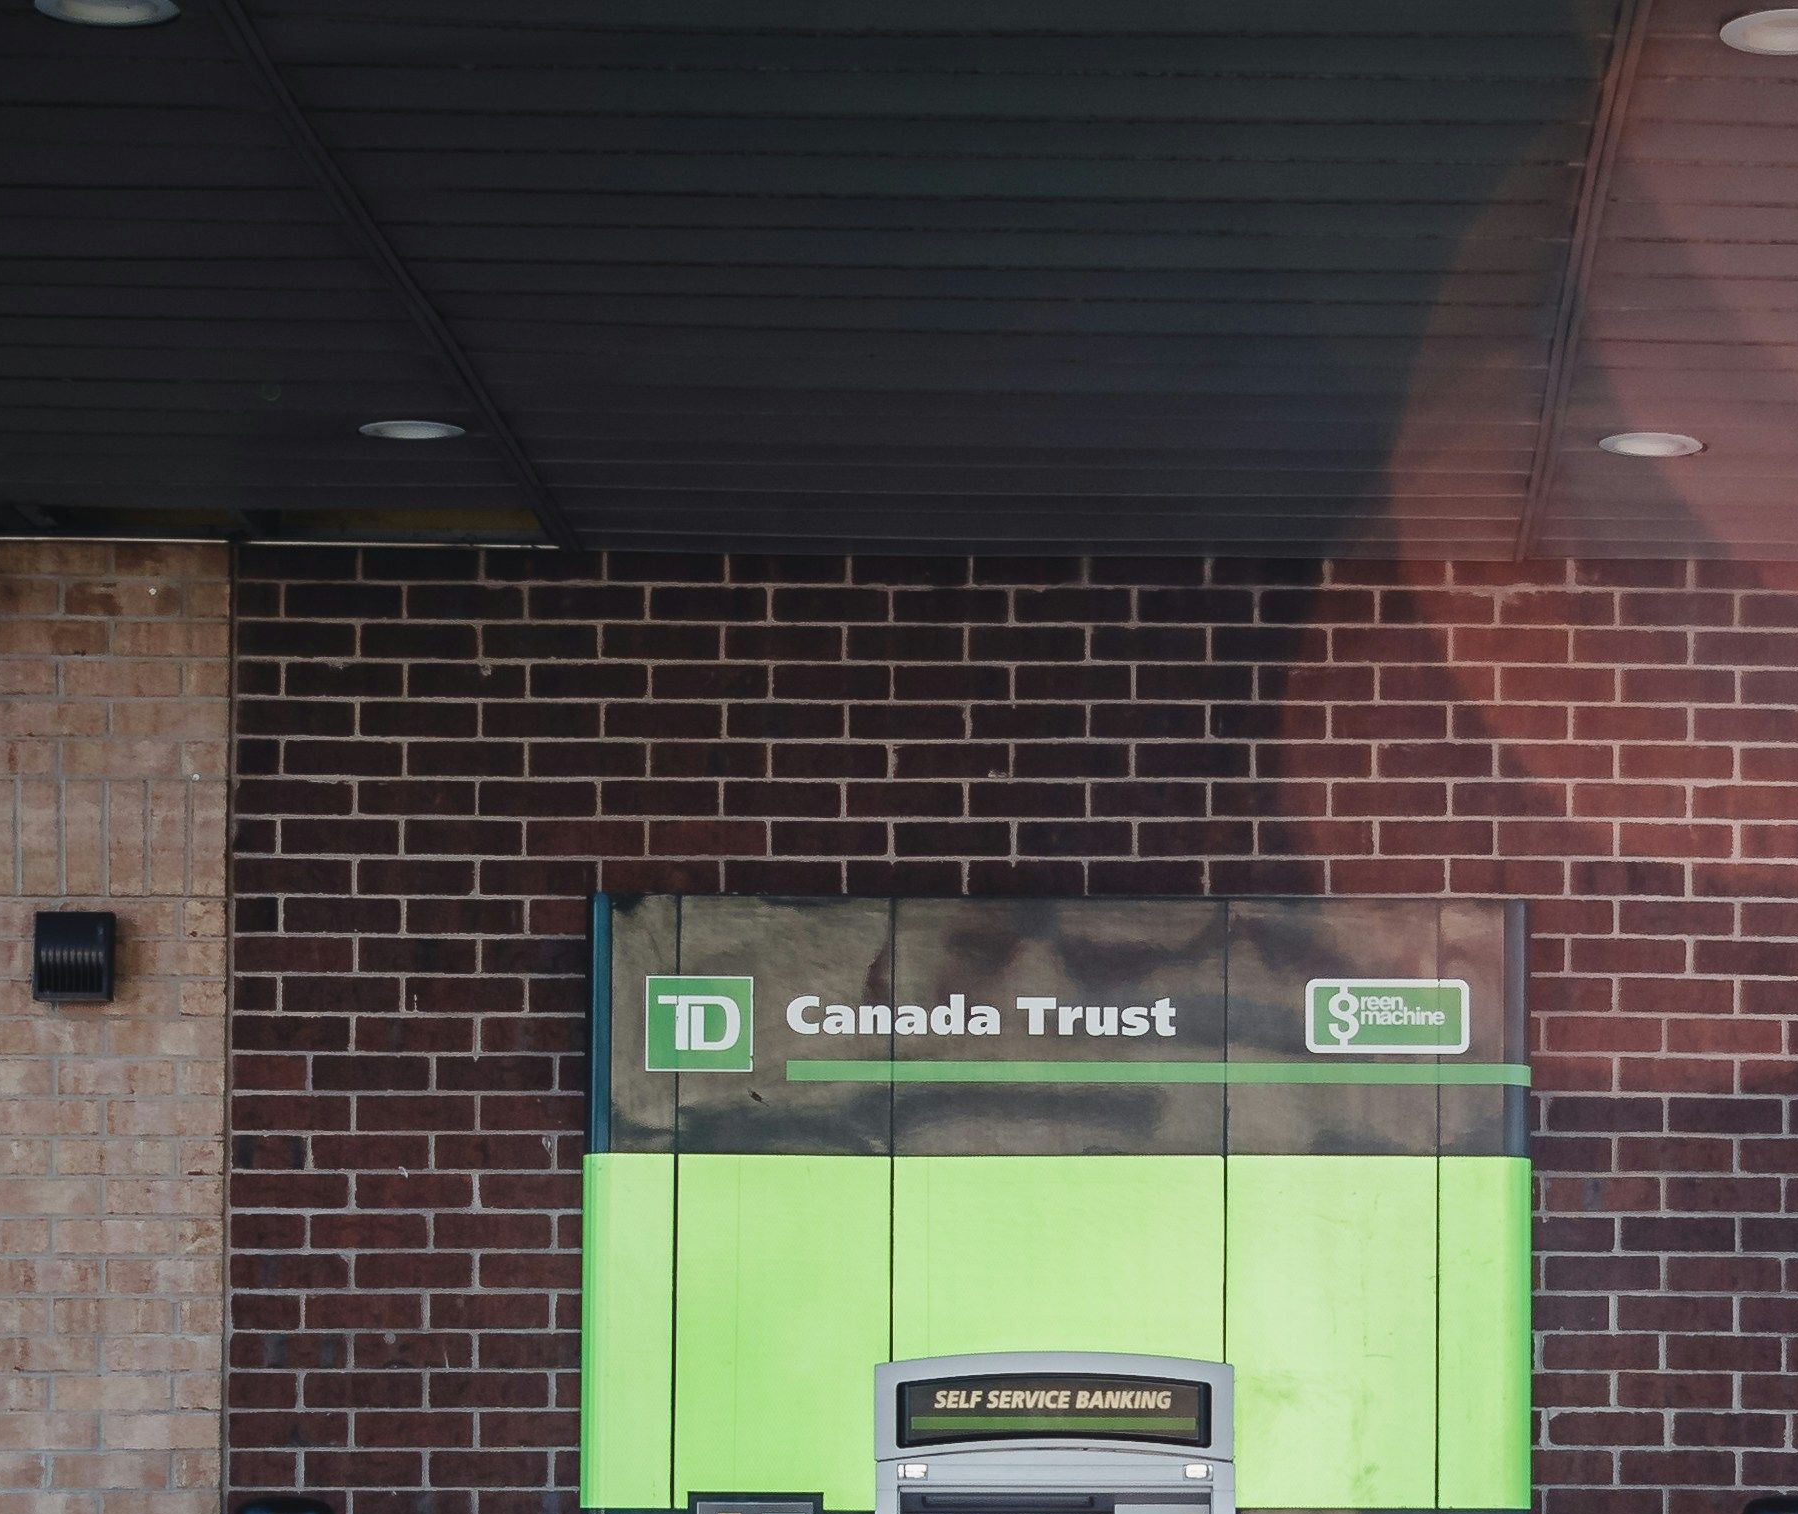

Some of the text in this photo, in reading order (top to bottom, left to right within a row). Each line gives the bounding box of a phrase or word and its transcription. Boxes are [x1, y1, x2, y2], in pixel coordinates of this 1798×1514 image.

[657, 993, 1177, 1051] TD Canada Trust
[1360, 1006, 1446, 1026] machine
[934, 1390, 1172, 1410] SELF SERVICE BANKING
